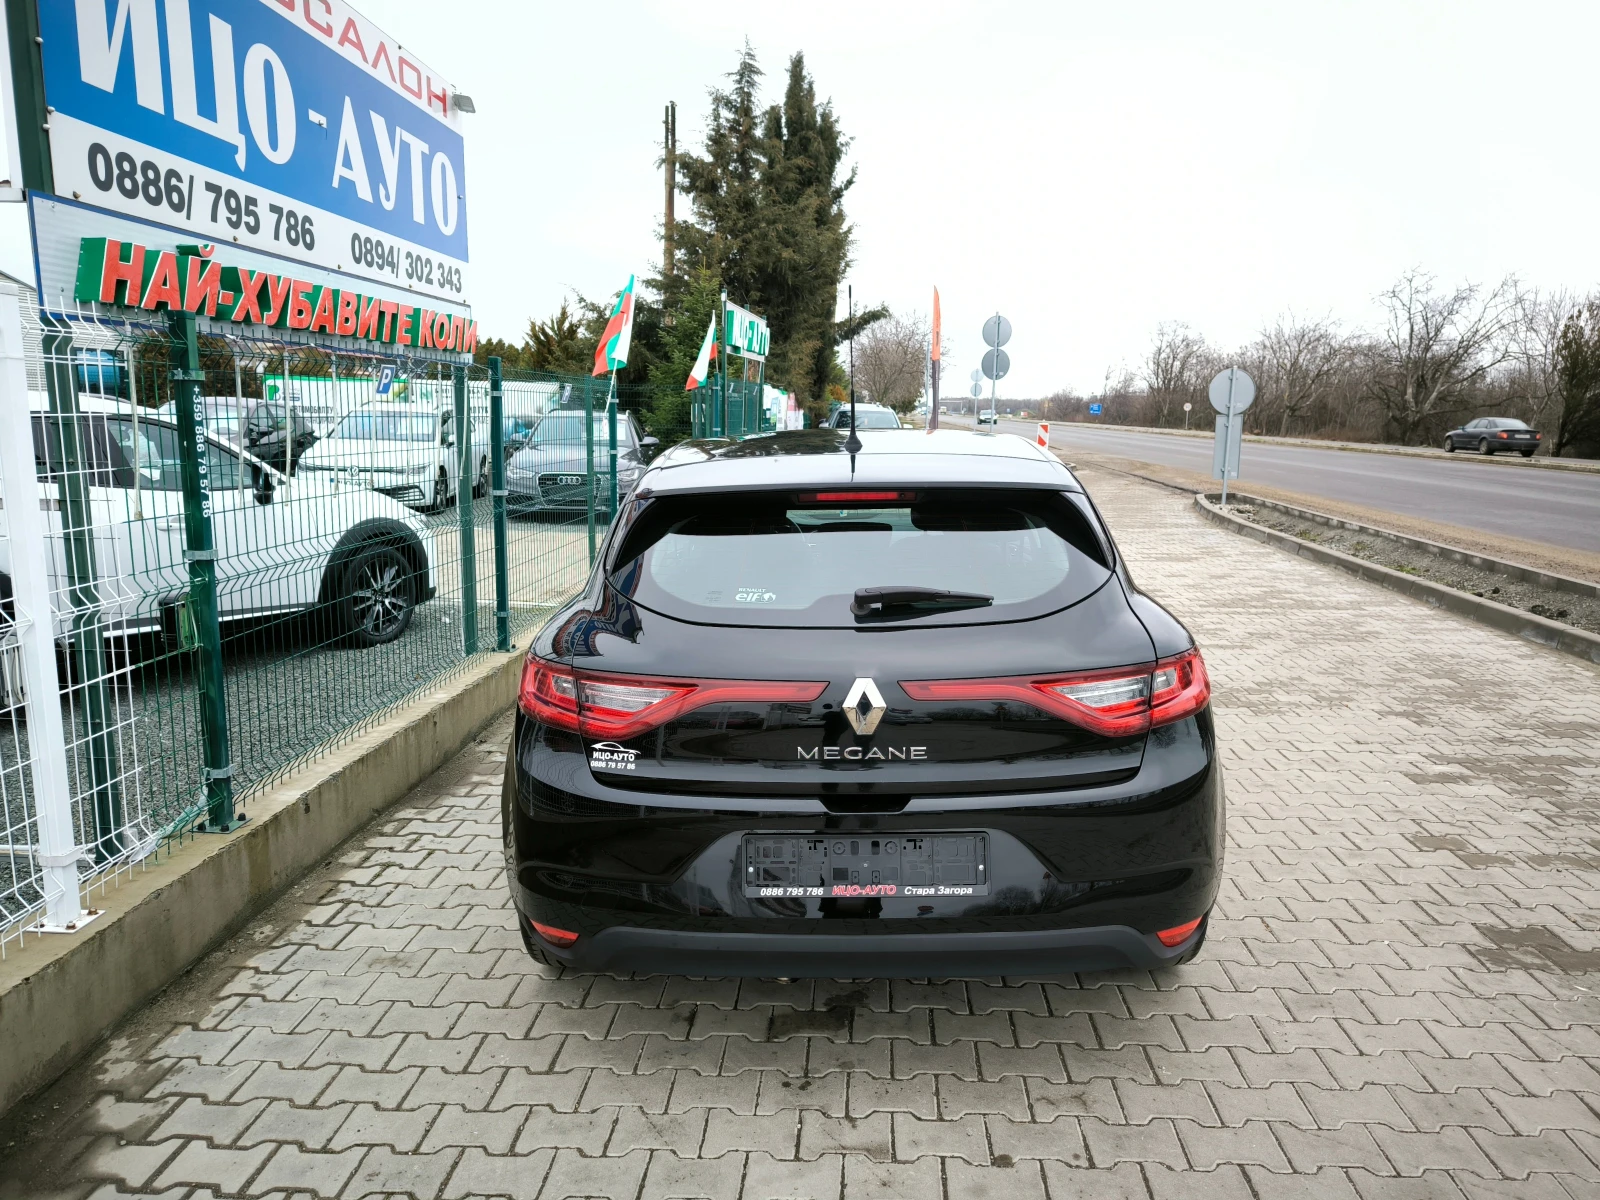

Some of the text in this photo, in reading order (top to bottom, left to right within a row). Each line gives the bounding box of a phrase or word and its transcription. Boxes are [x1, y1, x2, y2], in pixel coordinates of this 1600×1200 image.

[274, 0, 447, 118] САЛОН
[87, 142, 315, 251] 0886/ 795 786
[351, 232, 463, 294] 0894/ 302 343
[99, 236, 478, 354] НАЙ-ХУБАВИТЕ КОЛИ
[193, 385, 211, 518] +359 886 79 57 86
[735, 592, 762, 602] elf
[592, 751, 635, 761] ИЦО-АУТО
[797, 746, 928, 760] MEGANE
[760, 887, 824, 896] 0886 795 786
[832, 884, 897, 896] ИЦО-АУТО
[904, 886, 973, 896] Стара Загора
